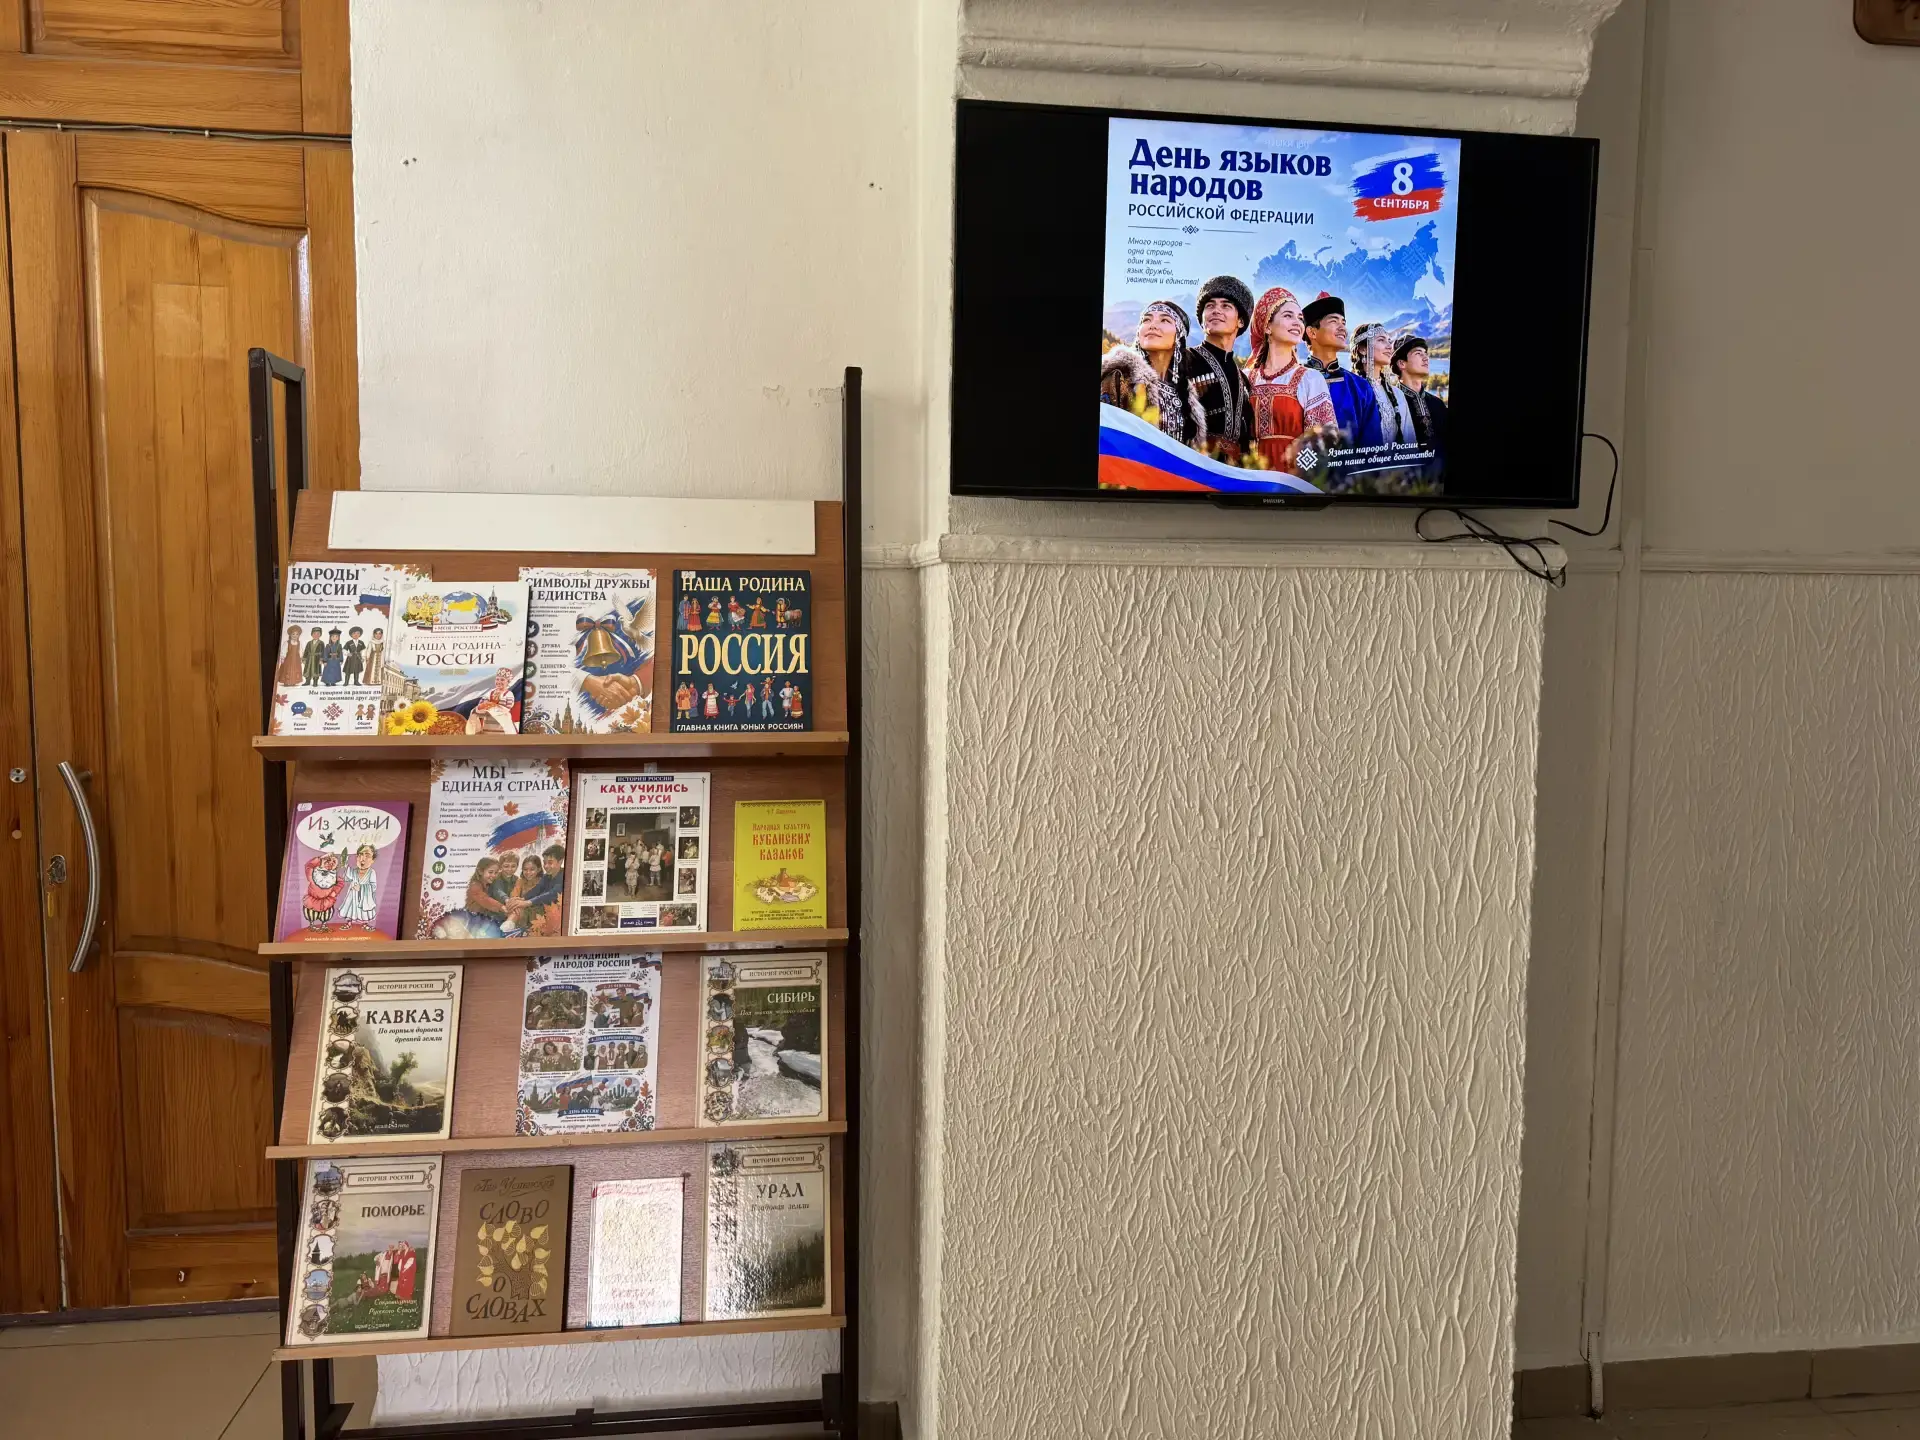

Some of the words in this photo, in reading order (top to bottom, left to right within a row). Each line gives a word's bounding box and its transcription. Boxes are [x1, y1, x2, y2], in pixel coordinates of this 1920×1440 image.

[1129, 138, 1210, 171] День
[1219, 150, 1332, 177] языков
[1391, 163, 1414, 196] 8
[1130, 173, 1263, 203] народов
[1373, 197, 1429, 211] СЕНТЯБРЯ
[1128, 203, 1225, 221] РОССИЙСКОЙ
[1230, 208, 1314, 225] ФЕДЕРАЦИИ
[1128, 237, 1151, 245] Много
[1146, 249, 1174, 257] страна,
[1166, 277, 1200, 285] единства!
[1328, 448, 1354, 458] Языки
[1355, 444, 1389, 455] народов
[1391, 442, 1419, 450] России
[1327, 460, 1343, 468] это
[1345, 458, 1365, 466] наше
[1367, 455, 1391, 466] общее
[1393, 449, 1435, 461] богатство!
[291, 567, 360, 583] НАРОДЫ
[290, 583, 358, 596] РОССИИ
[525, 578, 591, 589] СИМВОЛЫ
[594, 579, 650, 590] ДРУЖБЫ
[682, 577, 732, 591] НАША
[739, 577, 805, 593] РОДИНА
[537, 591, 607, 602] ЕДИНСТВА
[409, 643, 446, 651] НАША
[678, 633, 809, 675] РОССИЯ
[416, 652, 496, 666] РОССИЯ
[676, 724, 711, 732] ГЛАВНАЯ
[740, 723, 766, 731] ЮНЫХ
[472, 766, 506, 779] МЫ
[441, 781, 502, 793] ЕДИНАЯ
[507, 779, 560, 792] СТРАНА
[600, 784, 625, 793] КАК
[630, 784, 689, 793] УЧИЛИСЬ
[616, 795, 634, 804] НА
[639, 795, 672, 804] РУСИ
[553, 961, 594, 969] НАРОДОВ
[767, 991, 815, 1004] СИБИРЬ
[366, 1008, 445, 1025] КАВКАЗ
[756, 1182, 804, 1199] УРАЛ
[361, 1204, 425, 1218] ПОМОРЬЕ
[479, 1199, 550, 1225] СЛОВО
[493, 1276, 506, 1293] О
[466, 1293, 548, 1324] СЛОВАХ
